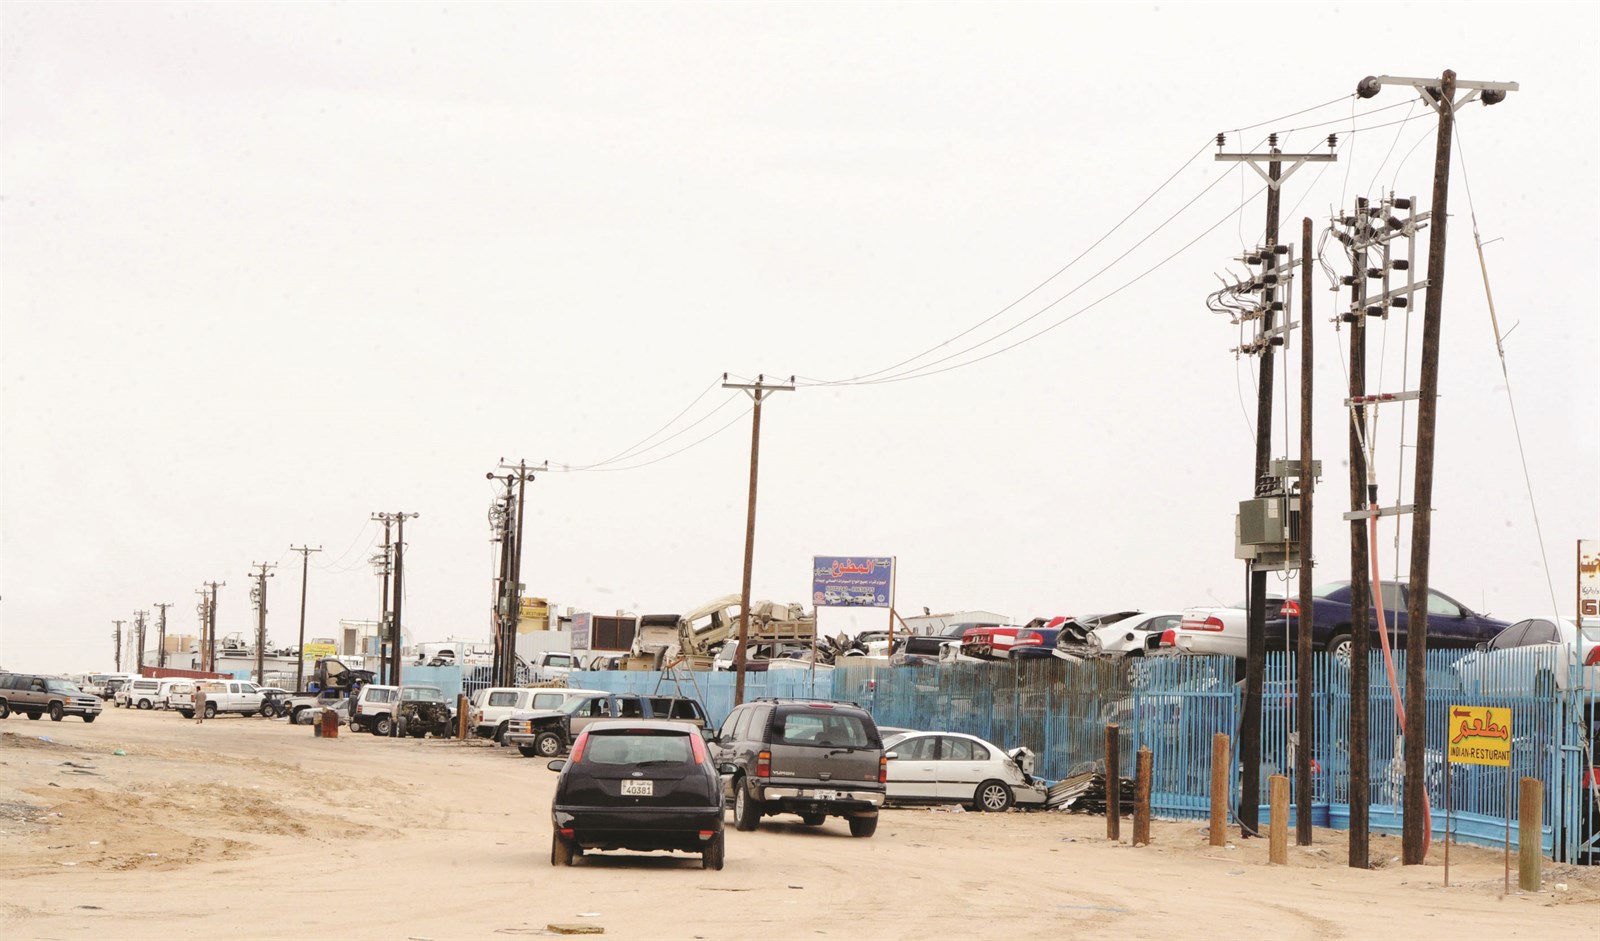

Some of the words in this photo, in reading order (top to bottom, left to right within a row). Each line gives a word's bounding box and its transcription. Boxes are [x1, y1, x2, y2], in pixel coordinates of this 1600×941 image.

[832, 558, 875, 577] المطوع
[464, 645, 494, 658] بيان
[1452, 710, 1508, 744] مطعم
[626, 786, 652, 795] 40381
